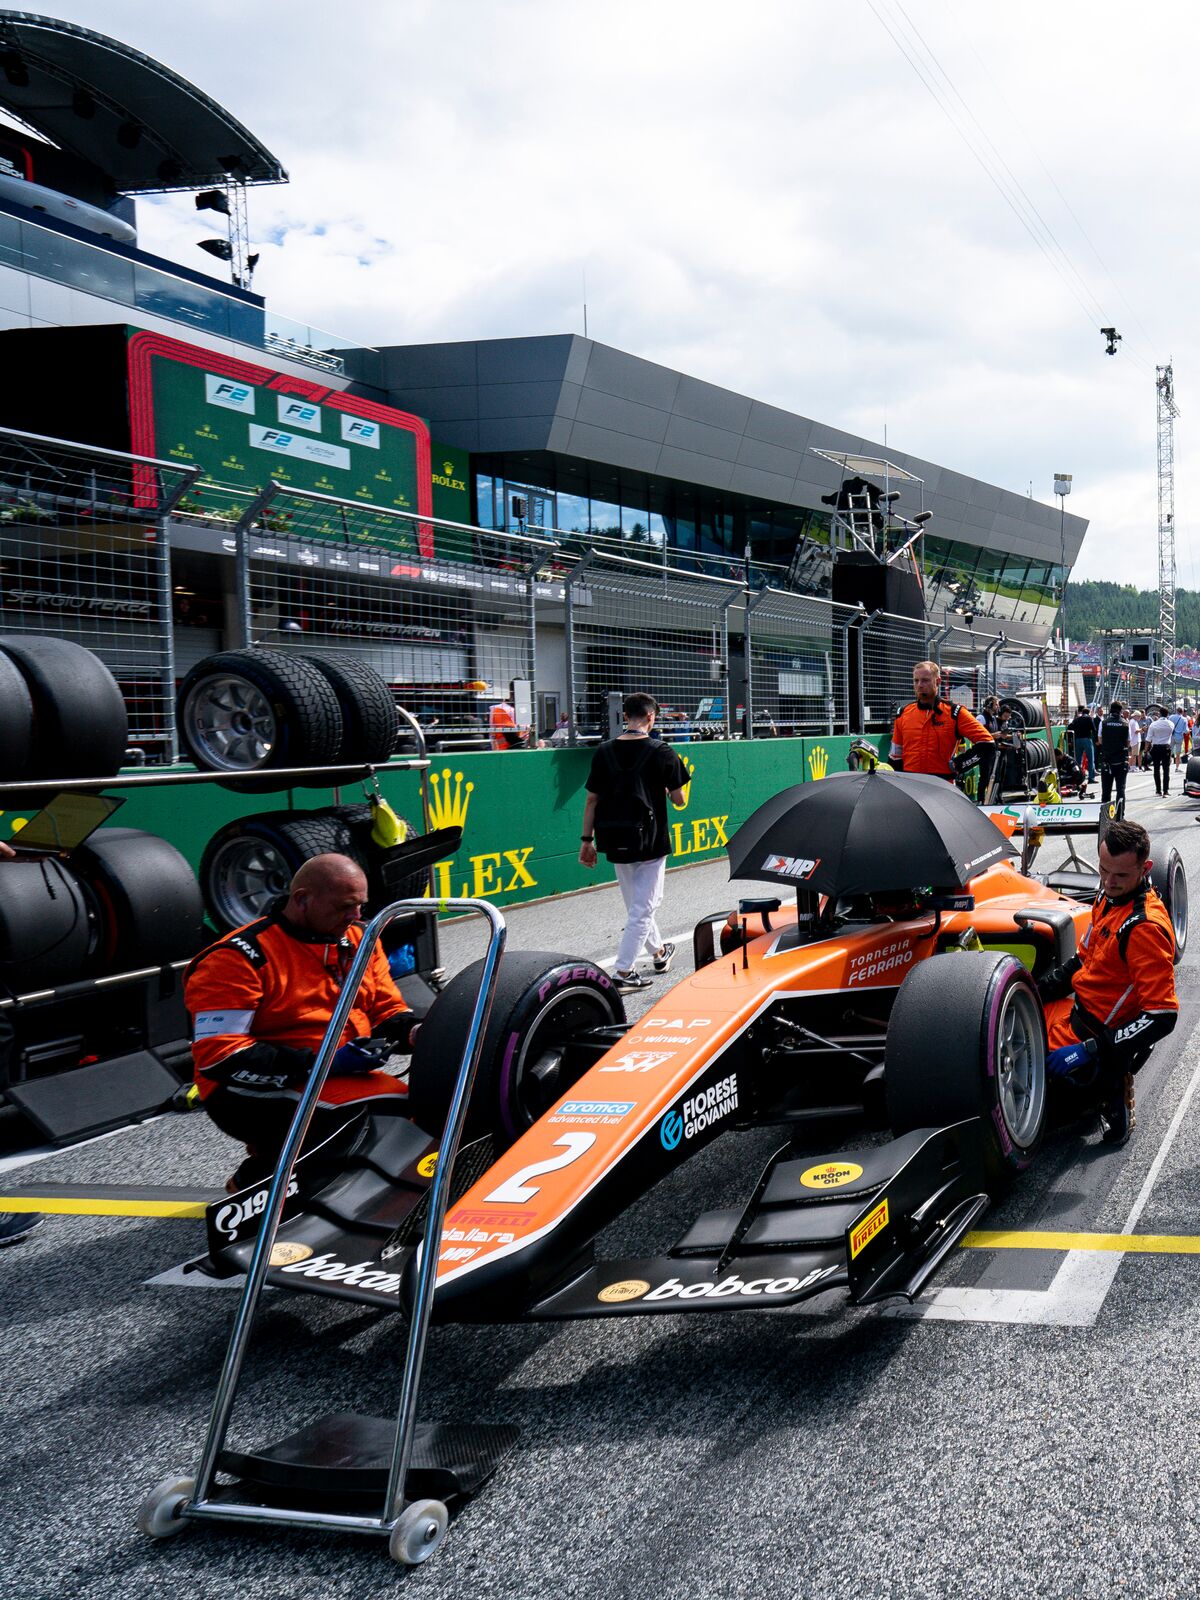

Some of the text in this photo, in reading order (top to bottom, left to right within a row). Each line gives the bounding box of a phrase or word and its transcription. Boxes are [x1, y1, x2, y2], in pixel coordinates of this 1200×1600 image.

[216, 383, 249, 401] F2
[286, 404, 317, 420] F2
[195, 430, 219, 441] ROLEX
[262, 431, 293, 447] F2
[348, 422, 376, 438] F2
[169, 449, 194, 459] ROLEX
[222, 460, 245, 471] ROLEX
[432, 474, 466, 492] ROLEX
[6, 588, 152, 613] SERGIO PEREZ
[365, 620, 441, 638] VERSTAPPEN
[695, 697, 723, 720] F2
[666, 815, 729, 858] LEX
[421, 846, 538, 899] LEX
[230, 936, 260, 959] HRX
[850, 938, 910, 969] TORNERIA
[848, 950, 913, 986] FERRARO
[538, 967, 611, 1002] P ZERO
[642, 1018, 712, 1029] PAP
[643, 1034, 697, 1046] winway
[682, 1071, 738, 1124] FIORESE
[561, 1103, 630, 1114] aramco
[684, 1094, 739, 1139] GIOVANNI
[548, 1115, 624, 1125] advanced fuel
[482, 1131, 597, 1204] 2
[812, 1169, 851, 1181] KROON
[823, 1176, 840, 1185] OIL
[448, 1209, 538, 1226] PIRELLI
[853, 1206, 886, 1252] PIRELLI
[642, 1264, 840, 1300] bobcoin
